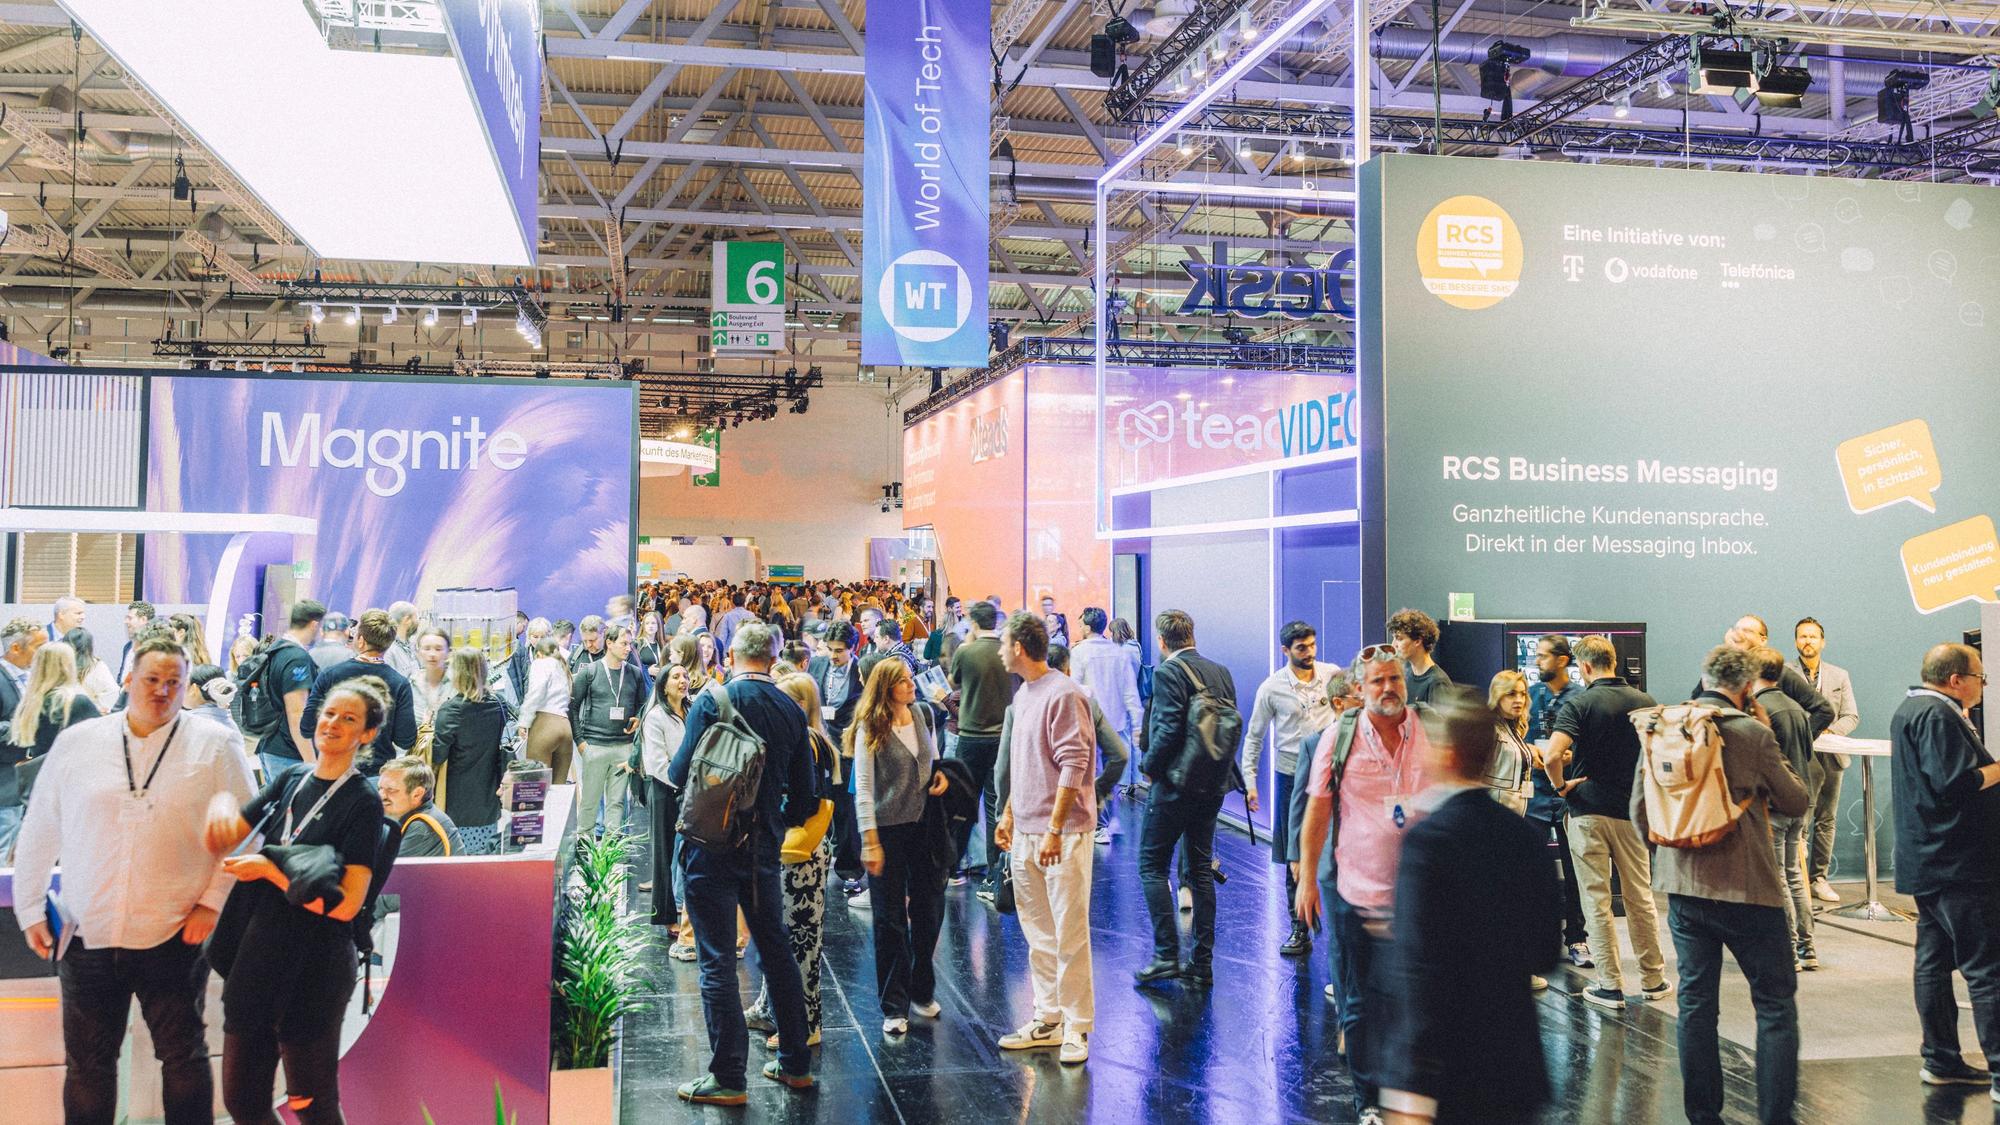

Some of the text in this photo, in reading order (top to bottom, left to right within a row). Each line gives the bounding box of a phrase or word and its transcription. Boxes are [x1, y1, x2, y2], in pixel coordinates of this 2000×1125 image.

[914, 25, 942, 231] World of Tech
[1446, 224, 1494, 244] RCS
[1563, 225, 1726, 248] Eine Initiative von:
[746, 260, 778, 305] 6
[1632, 264, 1698, 281] vodafone
[1720, 262, 1795, 281] Telefónica
[904, 281, 946, 310] WT
[1181, 400, 1290, 450] tea
[260, 411, 527, 497] Magnite
[665, 448, 679, 458] des
[1443, 456, 1778, 491] RCS Business Messaging
[1453, 504, 1769, 531] Ganzheitliche Kundenansprache.
[1466, 534, 1758, 558] Direkt in der Messaging Inbox.
[1922, 571, 1943, 586] neu
